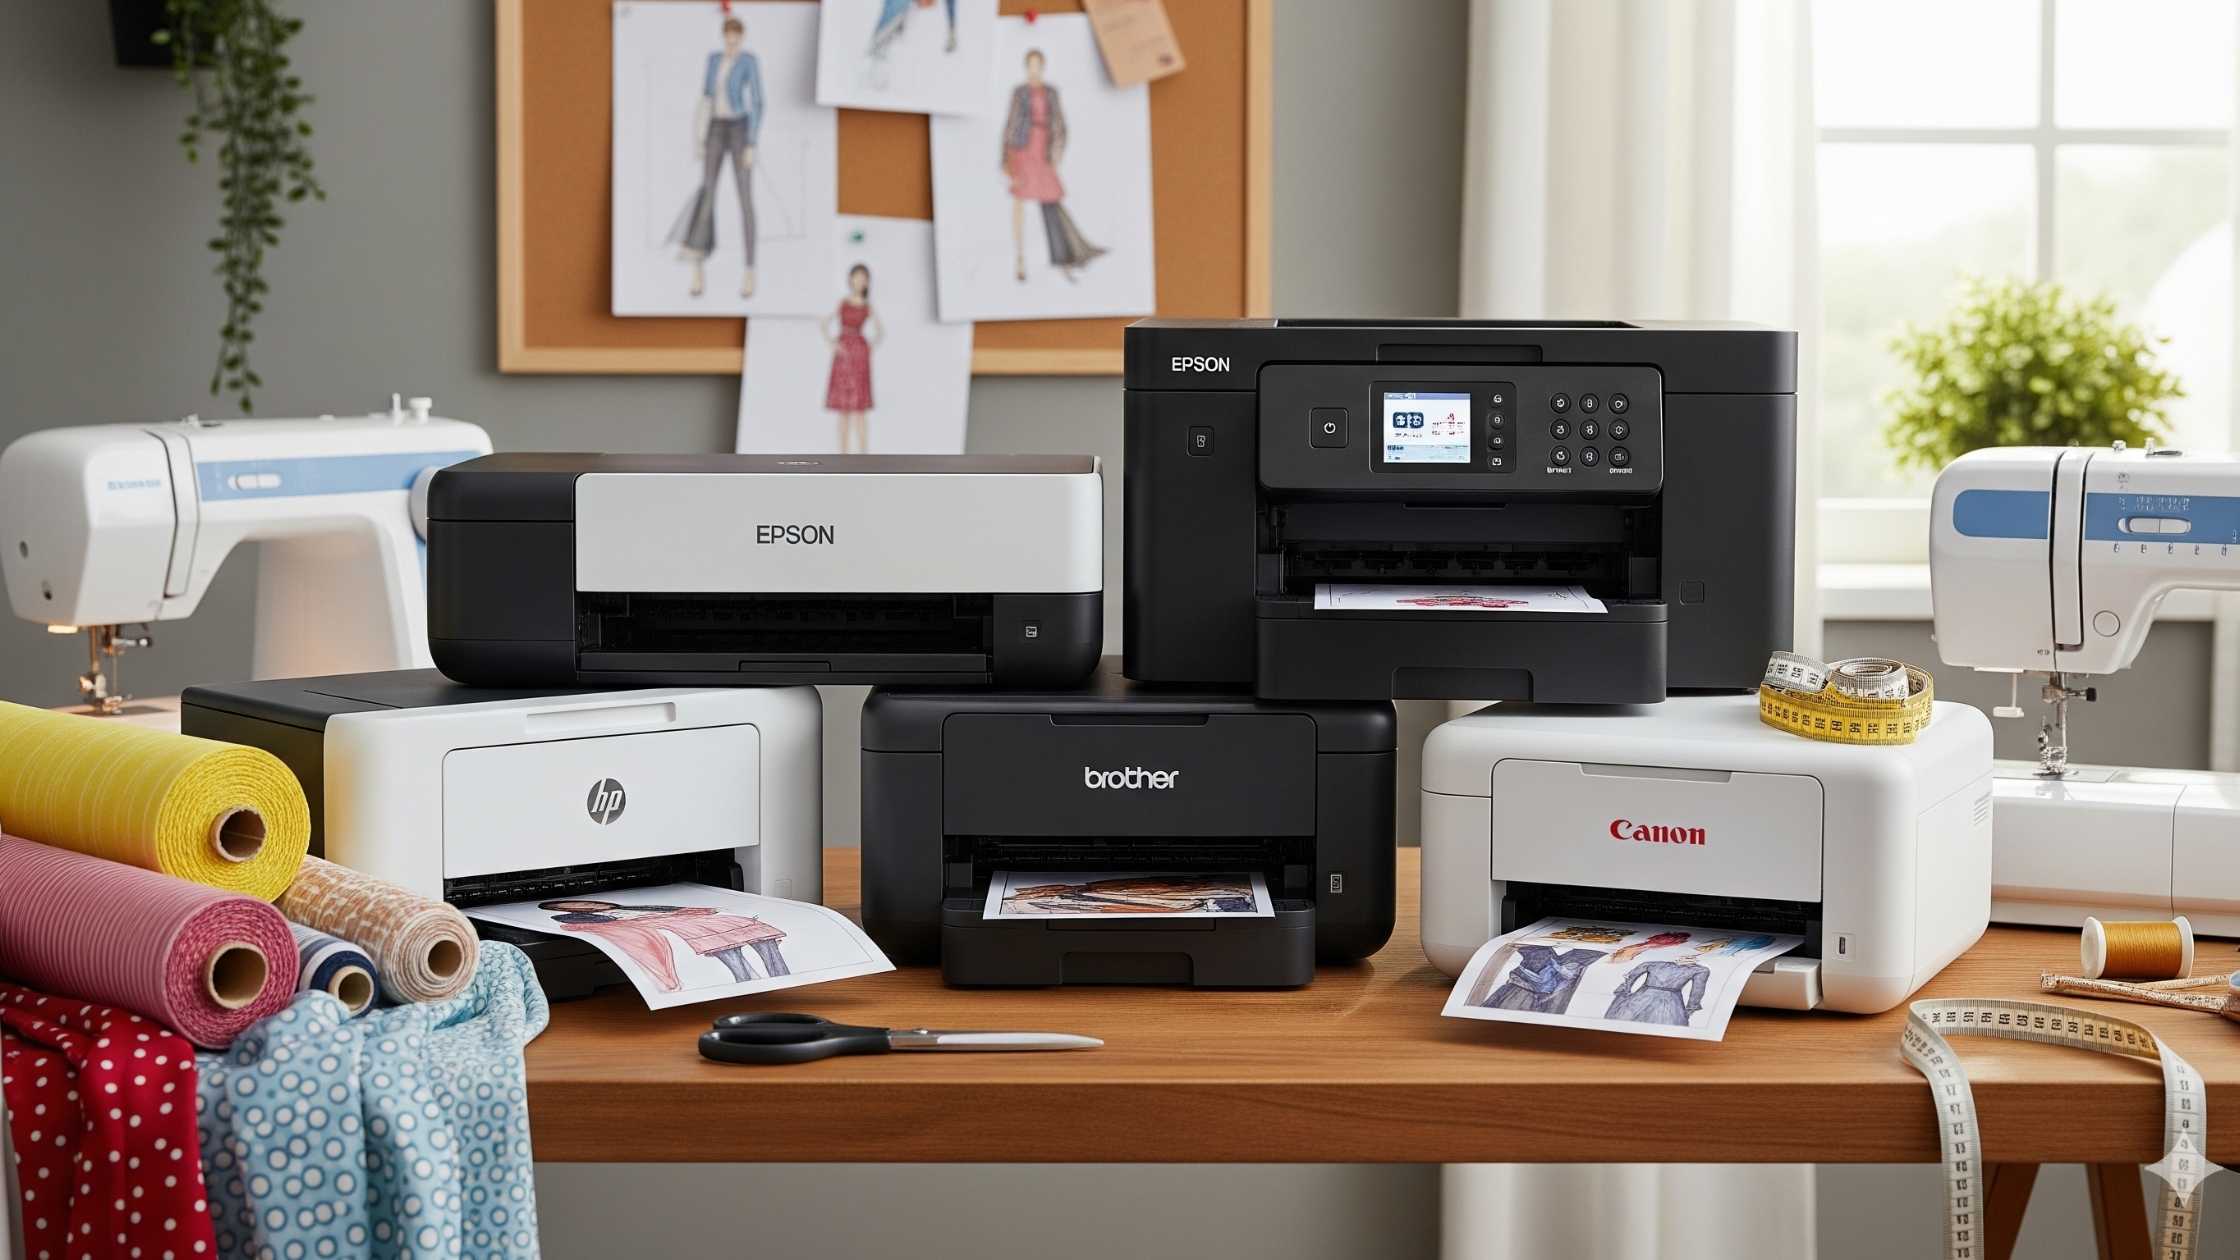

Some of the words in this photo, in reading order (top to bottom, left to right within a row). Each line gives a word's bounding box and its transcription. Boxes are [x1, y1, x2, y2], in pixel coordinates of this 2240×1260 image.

[1171, 356, 1230, 373] EPSON
[756, 524, 835, 545] EPSON
[1084, 766, 1180, 790] brother
[589, 778, 624, 825] hp
[1609, 819, 1706, 846] Canon
